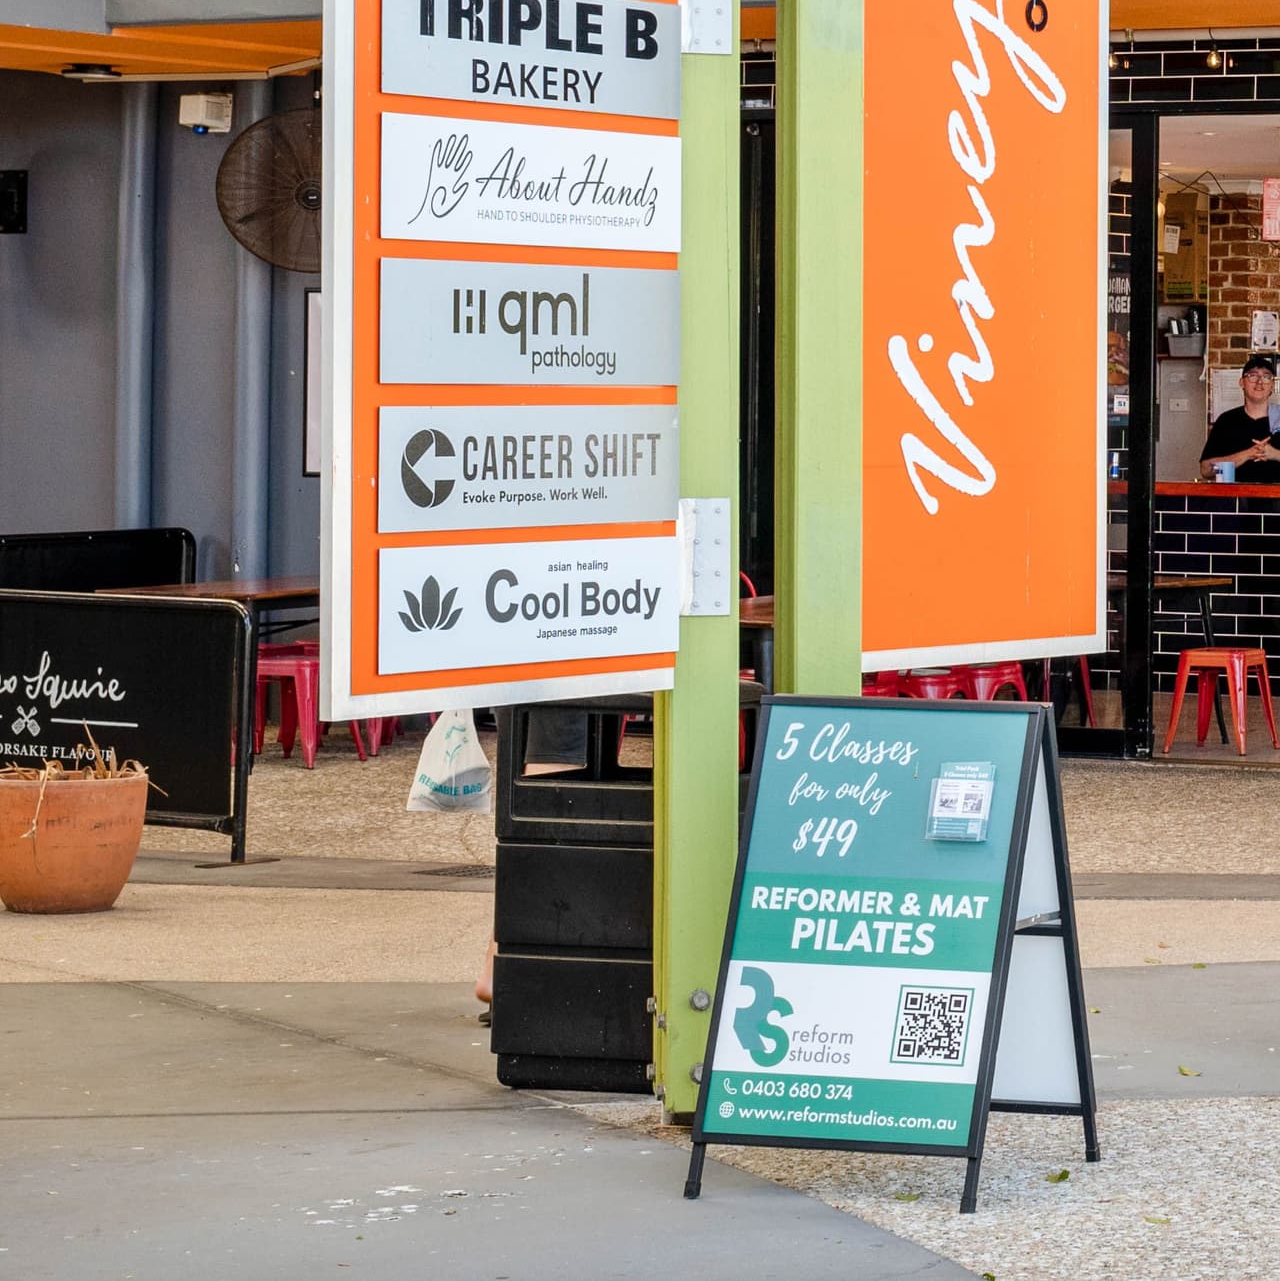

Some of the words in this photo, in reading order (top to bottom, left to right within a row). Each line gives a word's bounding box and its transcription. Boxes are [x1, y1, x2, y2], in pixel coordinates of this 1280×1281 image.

[625, 7, 659, 61] B
[471, 58, 603, 105] BAKERY
[475, 146, 566, 204] About
[567, 153, 659, 227] Handz
[477, 209, 503, 221] HAND
[506, 210, 516, 221] TO
[518, 211, 567, 226] SHOULDER
[569, 213, 640, 228] PHYSIOTHERAPY
[498, 273, 590, 356] qml
[531, 344, 616, 375] pathology
[462, 433, 573, 482] CAREER
[584, 432, 661, 479] SHIFT
[463, 491, 495, 505] Evoke
[499, 490, 546, 505] Purpose.
[549, 488, 578, 502] Work
[581, 488, 608, 501] Well.
[548, 561, 571, 572] asian
[576, 559, 609, 573] healing
[485, 568, 569, 623] Cool
[581, 578, 661, 620] Body
[536, 626, 577, 640] Japanese
[580, 624, 618, 638] massage
[23, 650, 126, 709] Squire
[776, 722, 804, 761] 5
[809, 722, 919, 766] Classes
[788, 772, 829, 806] for
[835, 772, 892, 815] only
[792, 817, 858, 858] $49
[751, 885, 895, 915] REFORMER
[900, 892, 922, 916] &
[929, 894, 989, 919] MAT
[791, 917, 935, 957] PILATES
[789, 1045, 851, 1065] studios
[792, 1027, 854, 1045] reform
[742, 1079, 785, 1097] 0403
[789, 1082, 822, 1099] 680
[824, 1084, 854, 1101] 374
[739, 1105, 957, 1132] www.reformstudios.com.au
